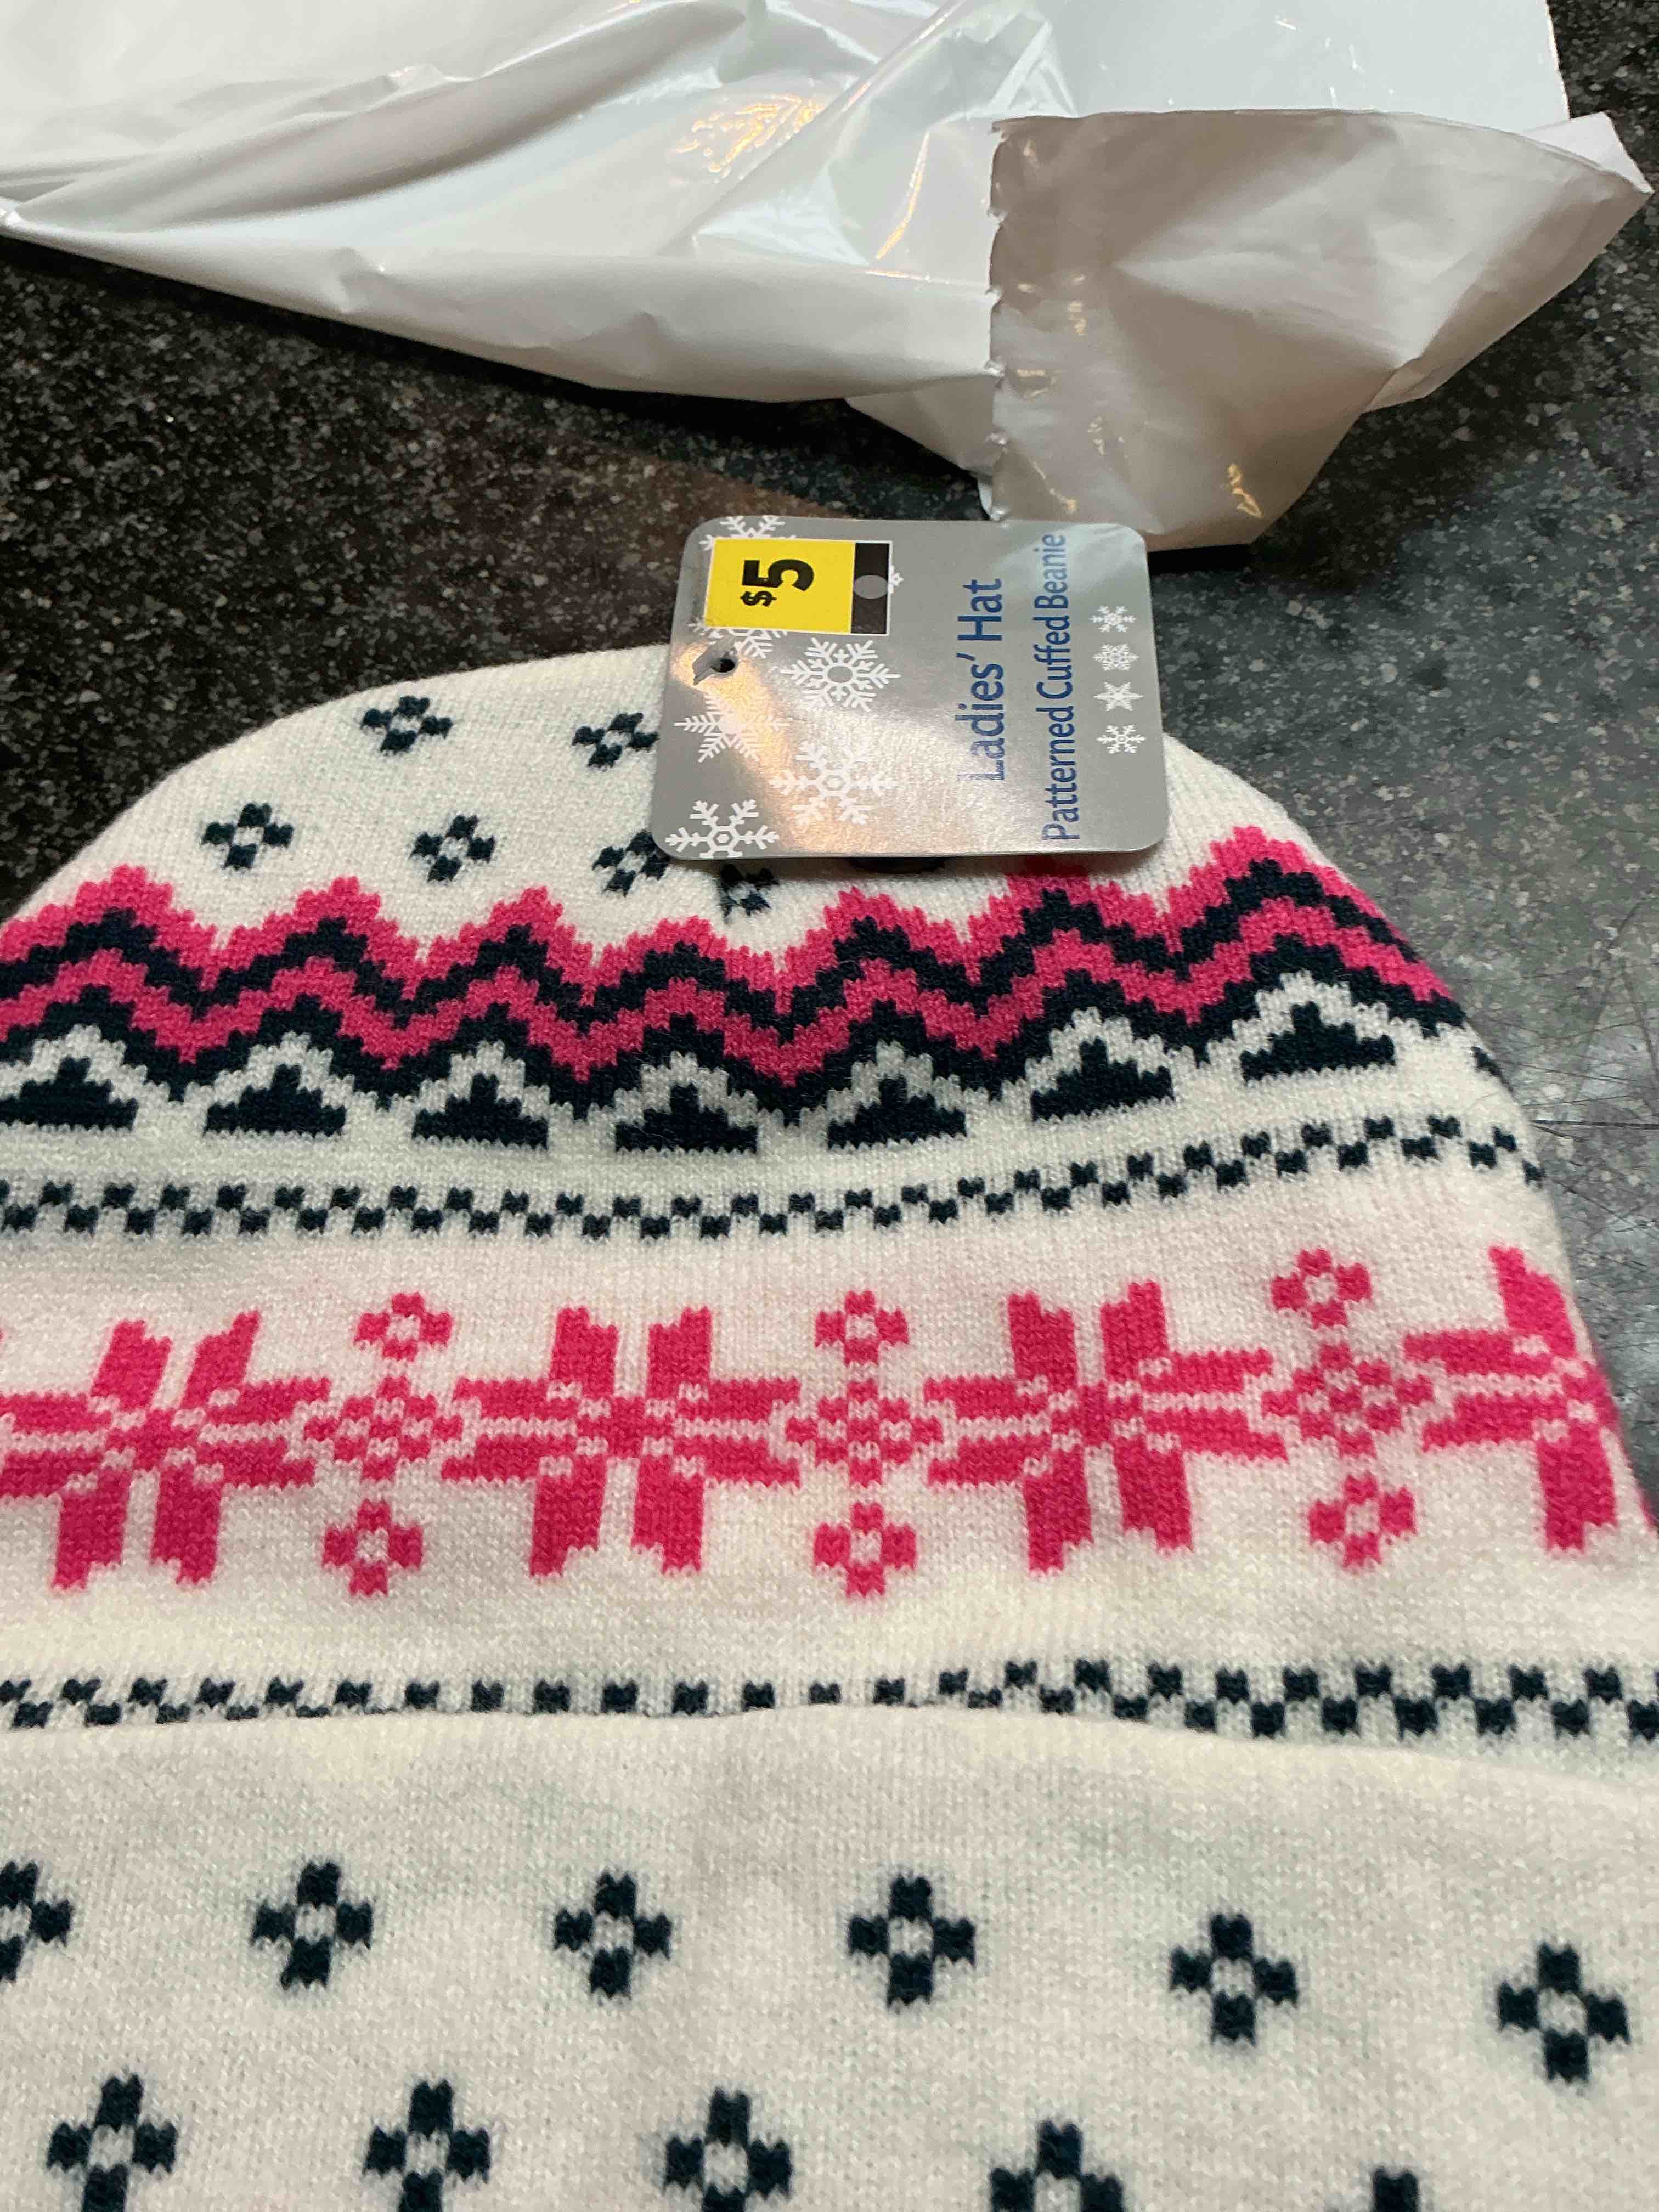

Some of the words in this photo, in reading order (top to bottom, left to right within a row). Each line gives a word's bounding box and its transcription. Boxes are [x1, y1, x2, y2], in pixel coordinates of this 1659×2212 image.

[740, 558, 815, 607] $5
[957, 578, 1003, 641] Hat
[1033, 534, 1068, 610] Beanie
[1032, 615, 1073, 699] Cuffed
[955, 652, 1005, 781] Ladies'
[1035, 706, 1080, 840] Patterned
